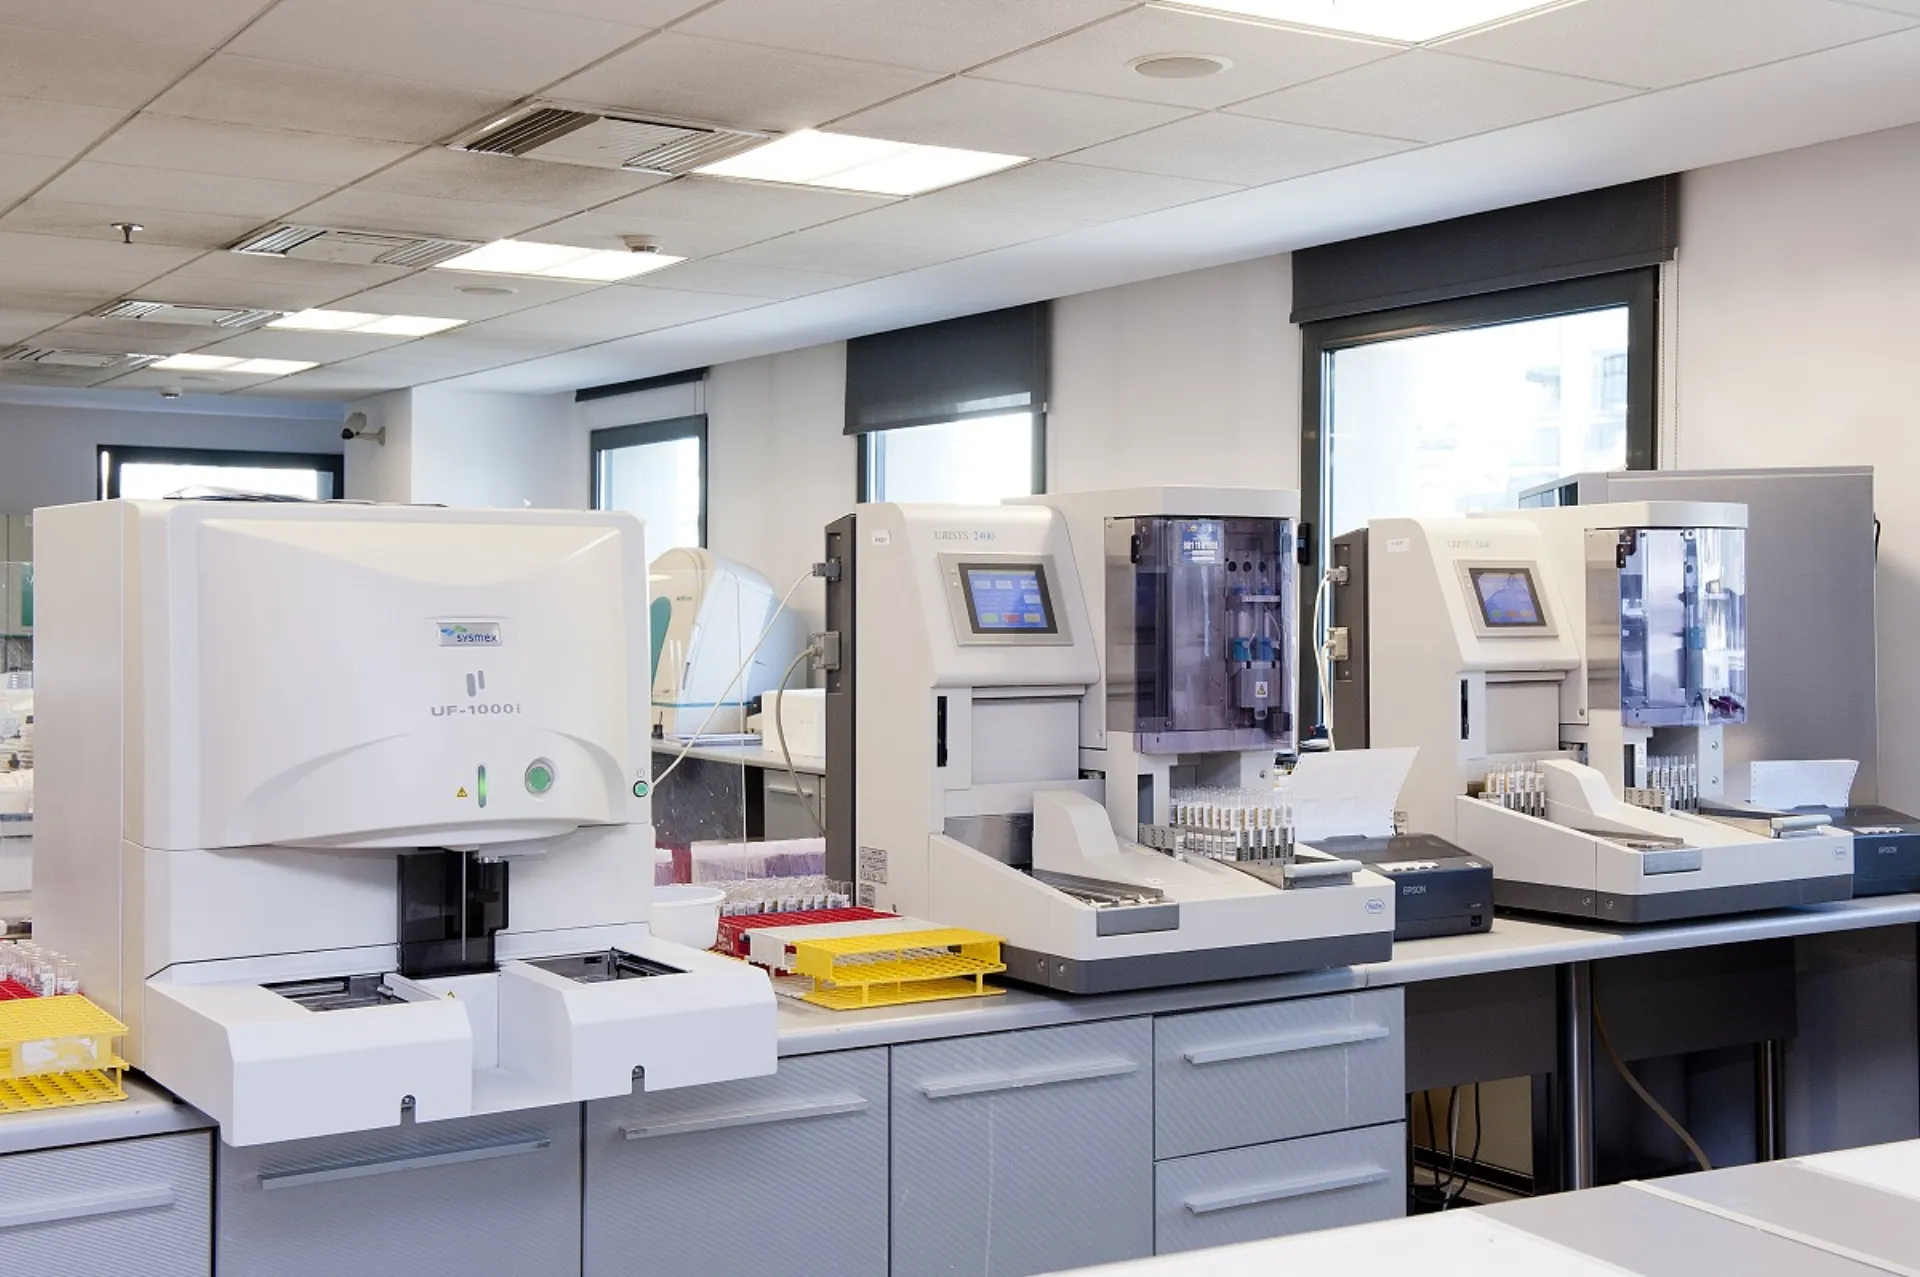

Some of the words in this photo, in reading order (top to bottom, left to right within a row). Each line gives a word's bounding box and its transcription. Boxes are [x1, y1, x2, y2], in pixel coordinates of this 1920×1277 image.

[456, 632, 498, 643] sysmex
[430, 703, 522, 717] UF-1000i
[1402, 885, 1427, 896] EPSON
